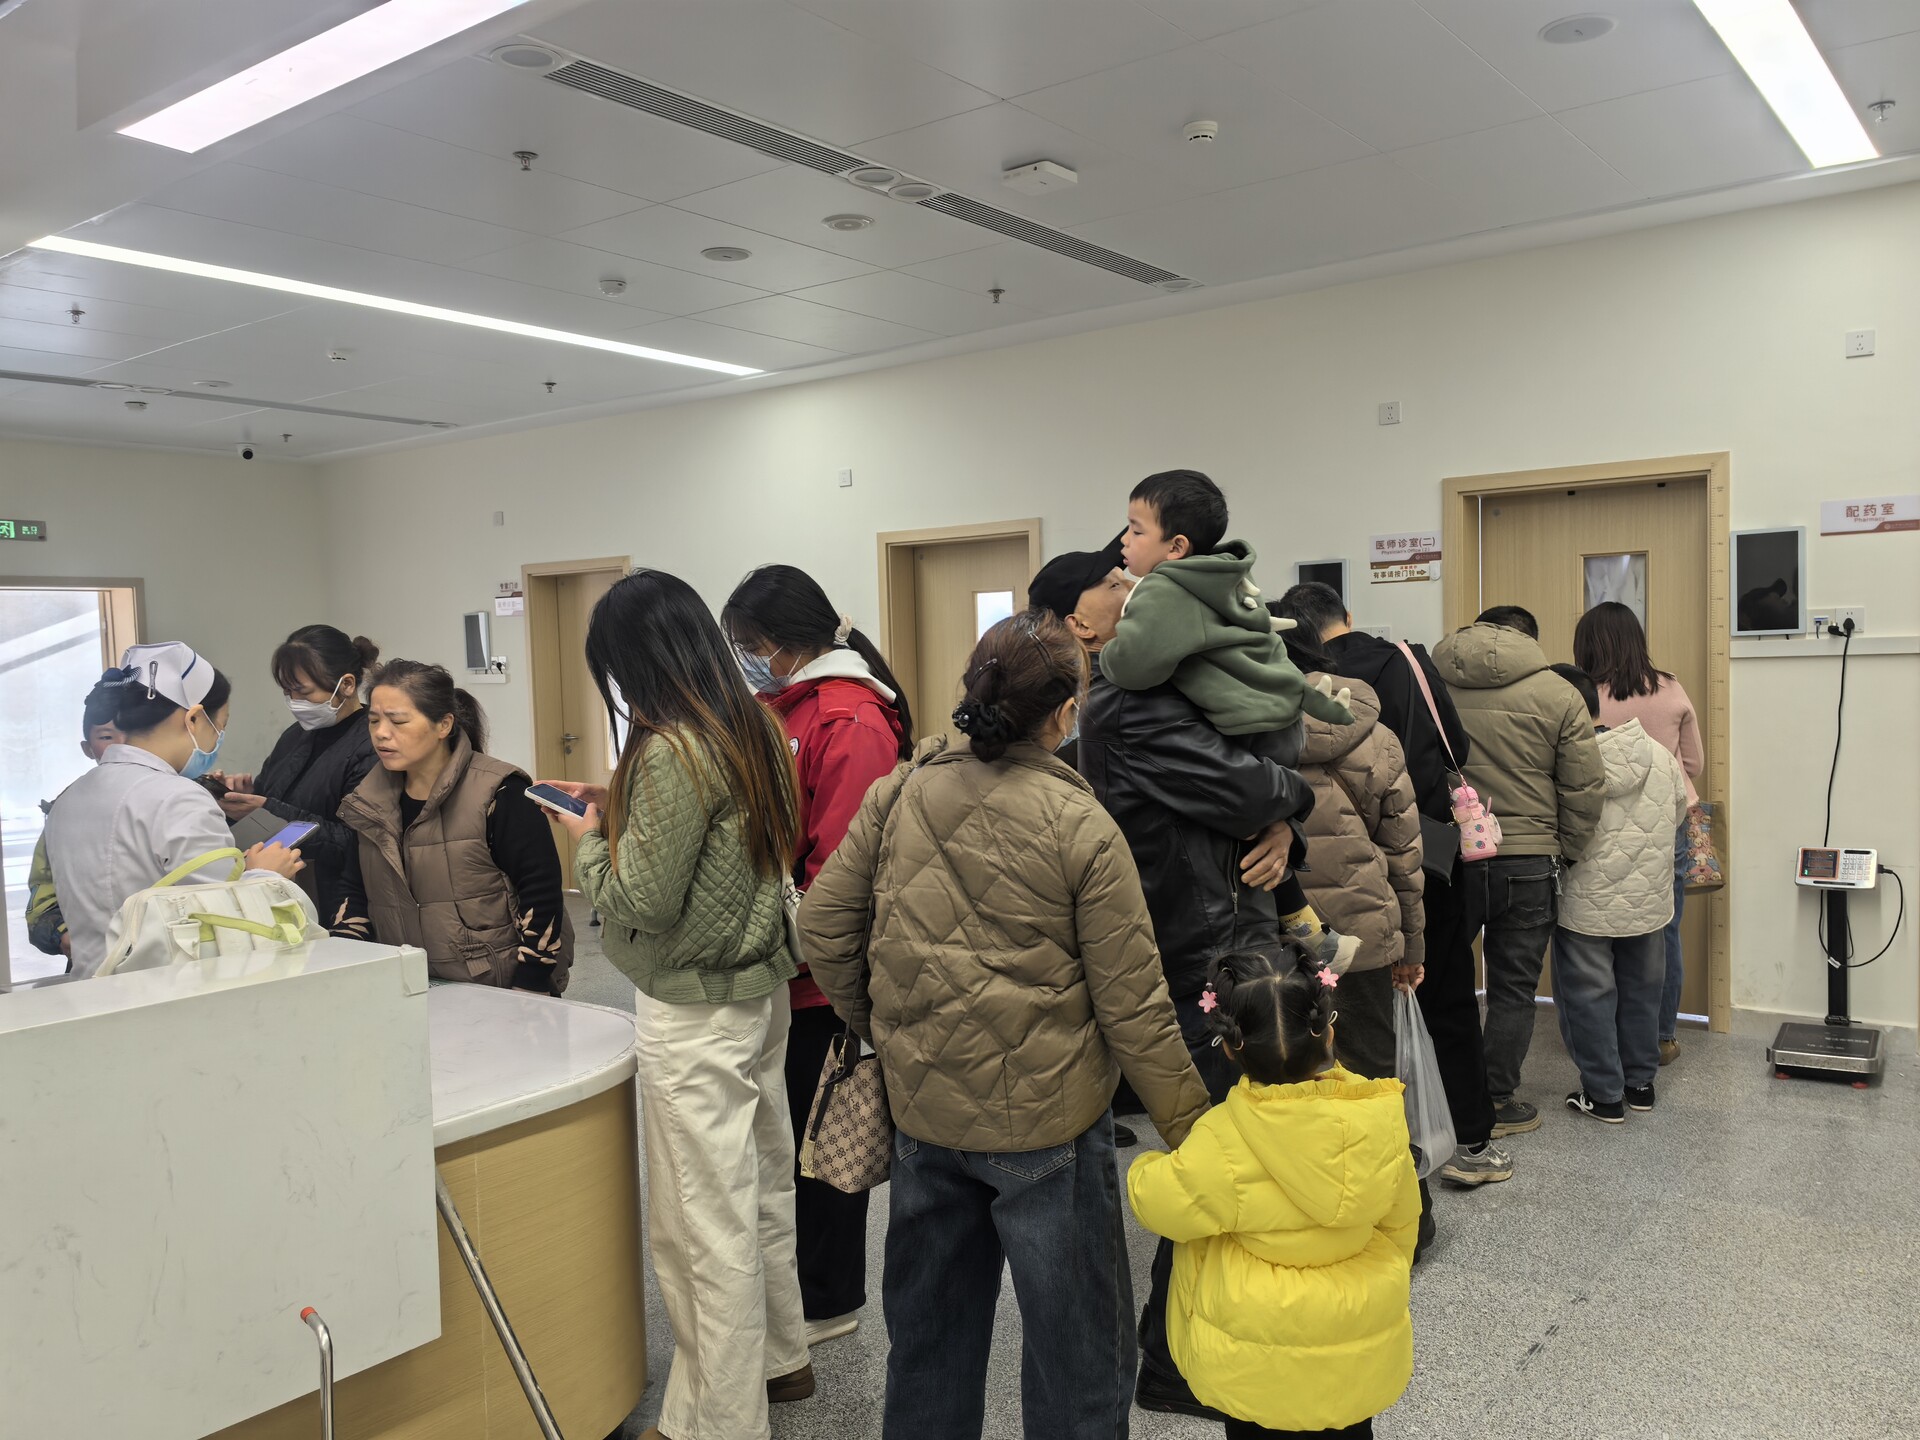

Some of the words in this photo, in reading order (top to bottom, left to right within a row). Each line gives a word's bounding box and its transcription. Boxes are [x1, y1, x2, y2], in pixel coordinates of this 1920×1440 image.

[1845, 503, 1894, 518] 配药室
[1375, 537, 1436, 550] 医师诊室(二)
[1373, 569, 1415, 579] 有事请按门铃
